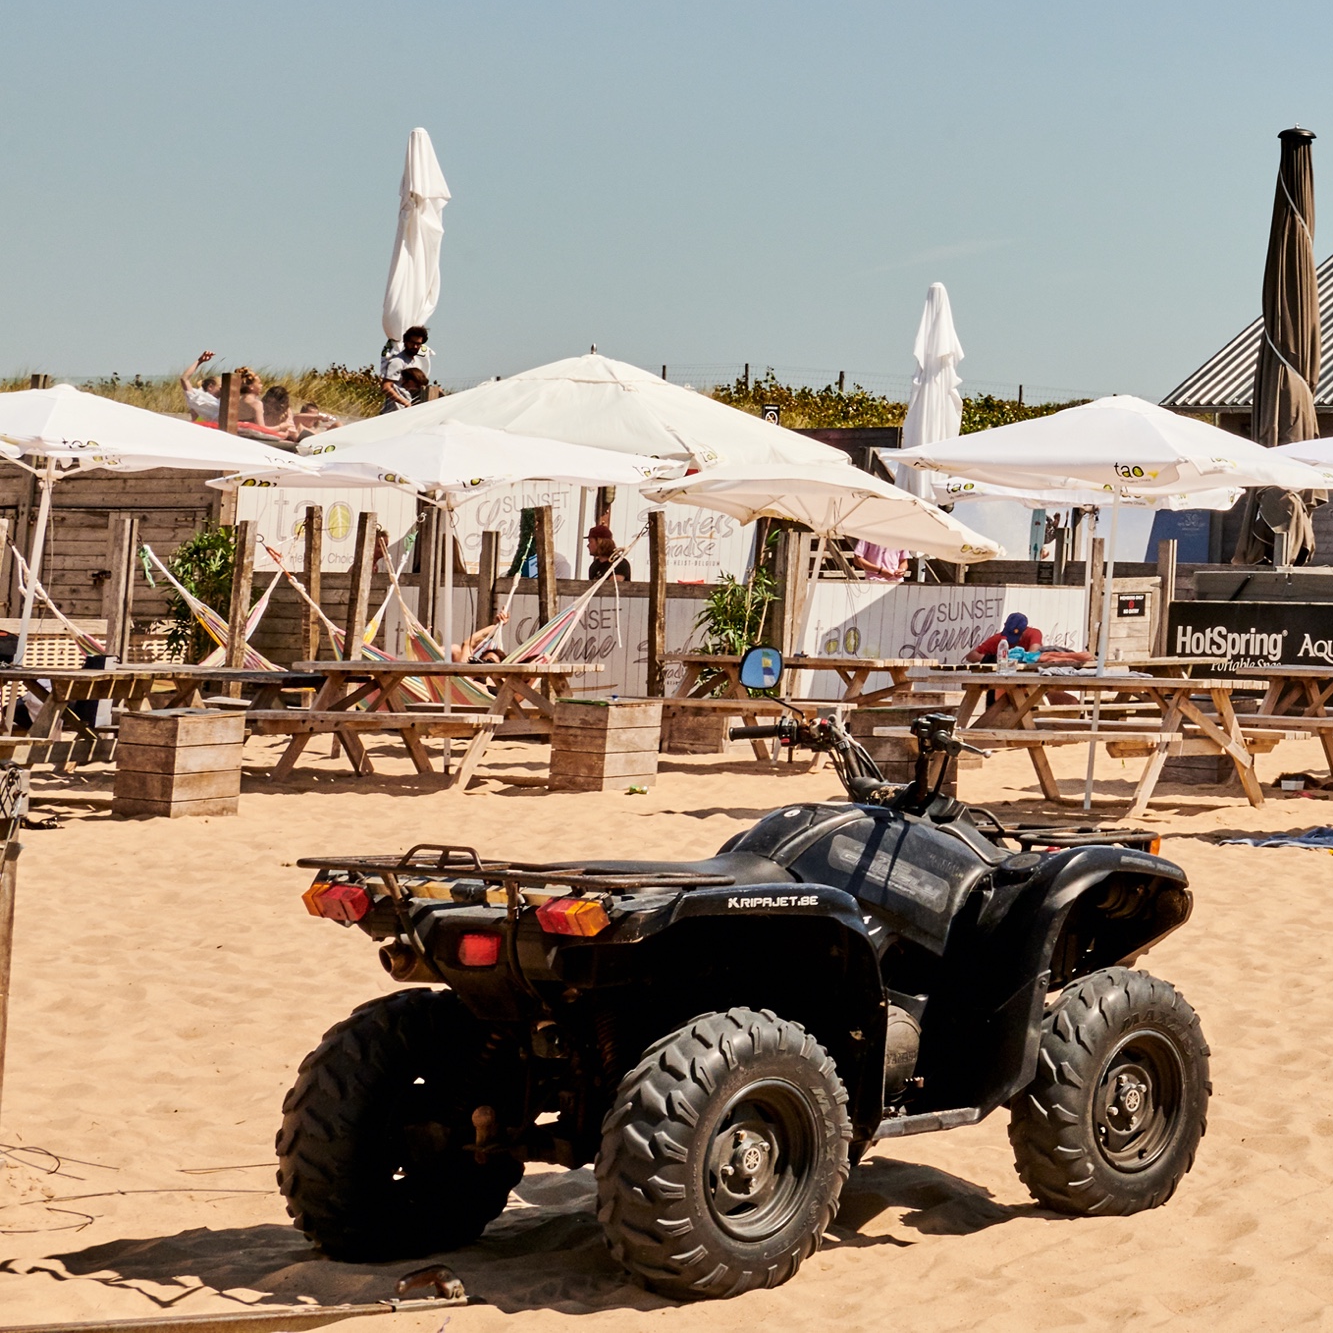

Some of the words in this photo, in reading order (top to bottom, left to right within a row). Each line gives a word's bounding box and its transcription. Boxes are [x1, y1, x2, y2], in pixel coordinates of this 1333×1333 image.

[309, 444, 336, 455] ao
[1113, 462, 1144, 478] tao
[946, 482, 975, 494] tao
[503, 491, 570, 513] SUNSET
[327, 552, 355, 564] Choic
[663, 536, 716, 559] aradise
[578, 608, 623, 631] NSET
[937, 598, 1003, 622] SUNSET
[814, 619, 862, 655] tao
